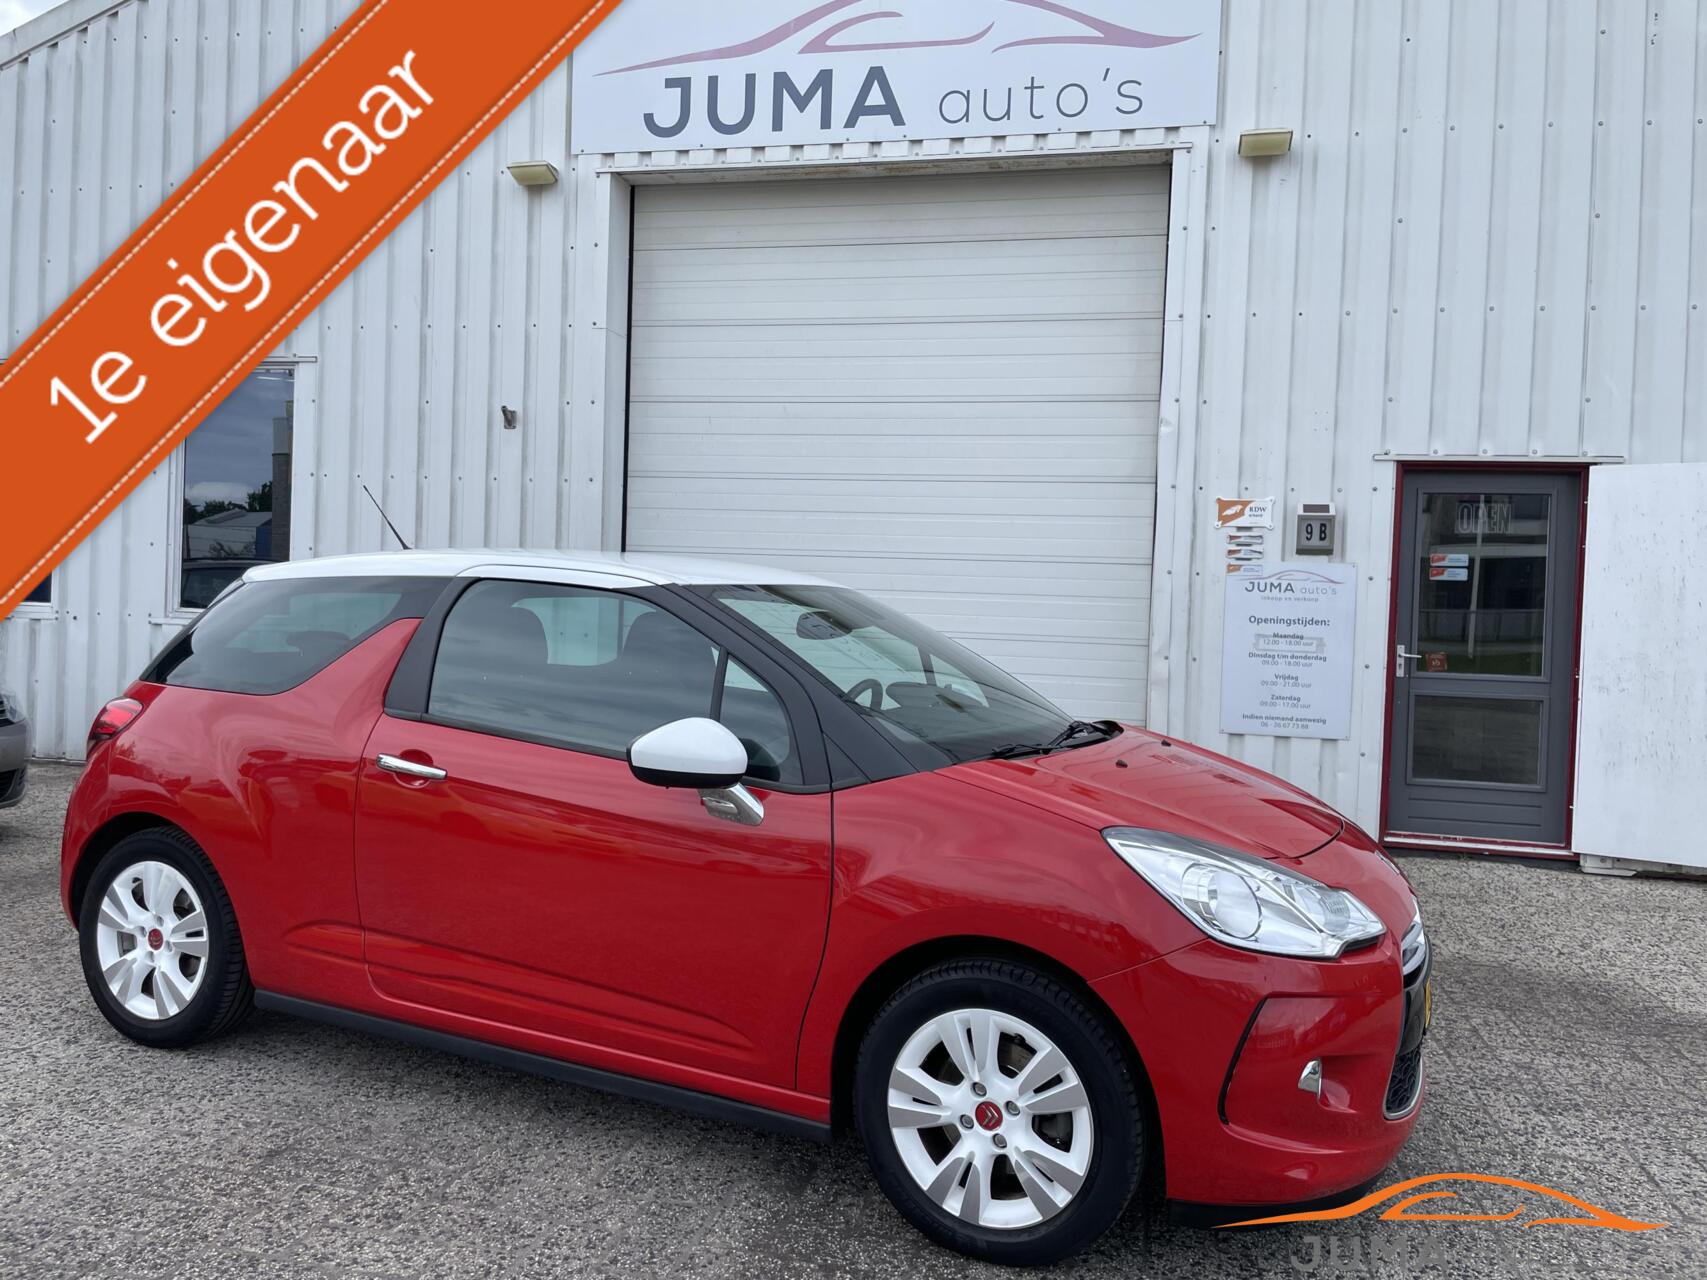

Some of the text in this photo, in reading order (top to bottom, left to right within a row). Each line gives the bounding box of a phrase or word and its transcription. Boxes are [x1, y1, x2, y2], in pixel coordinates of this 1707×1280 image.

[643, 66, 1144, 138] JUMA auto's
[1457, 503, 1511, 534] OPEN
[1245, 581, 1337, 595] JUMA auto's
[1248, 615, 1330, 627] Openingstijden:
[1272, 632, 1304, 640] Maandag
[1248, 652, 1276, 660] Dinsdag
[1290, 654, 1327, 662] donderdag
[1264, 714, 1294, 722] niemand
